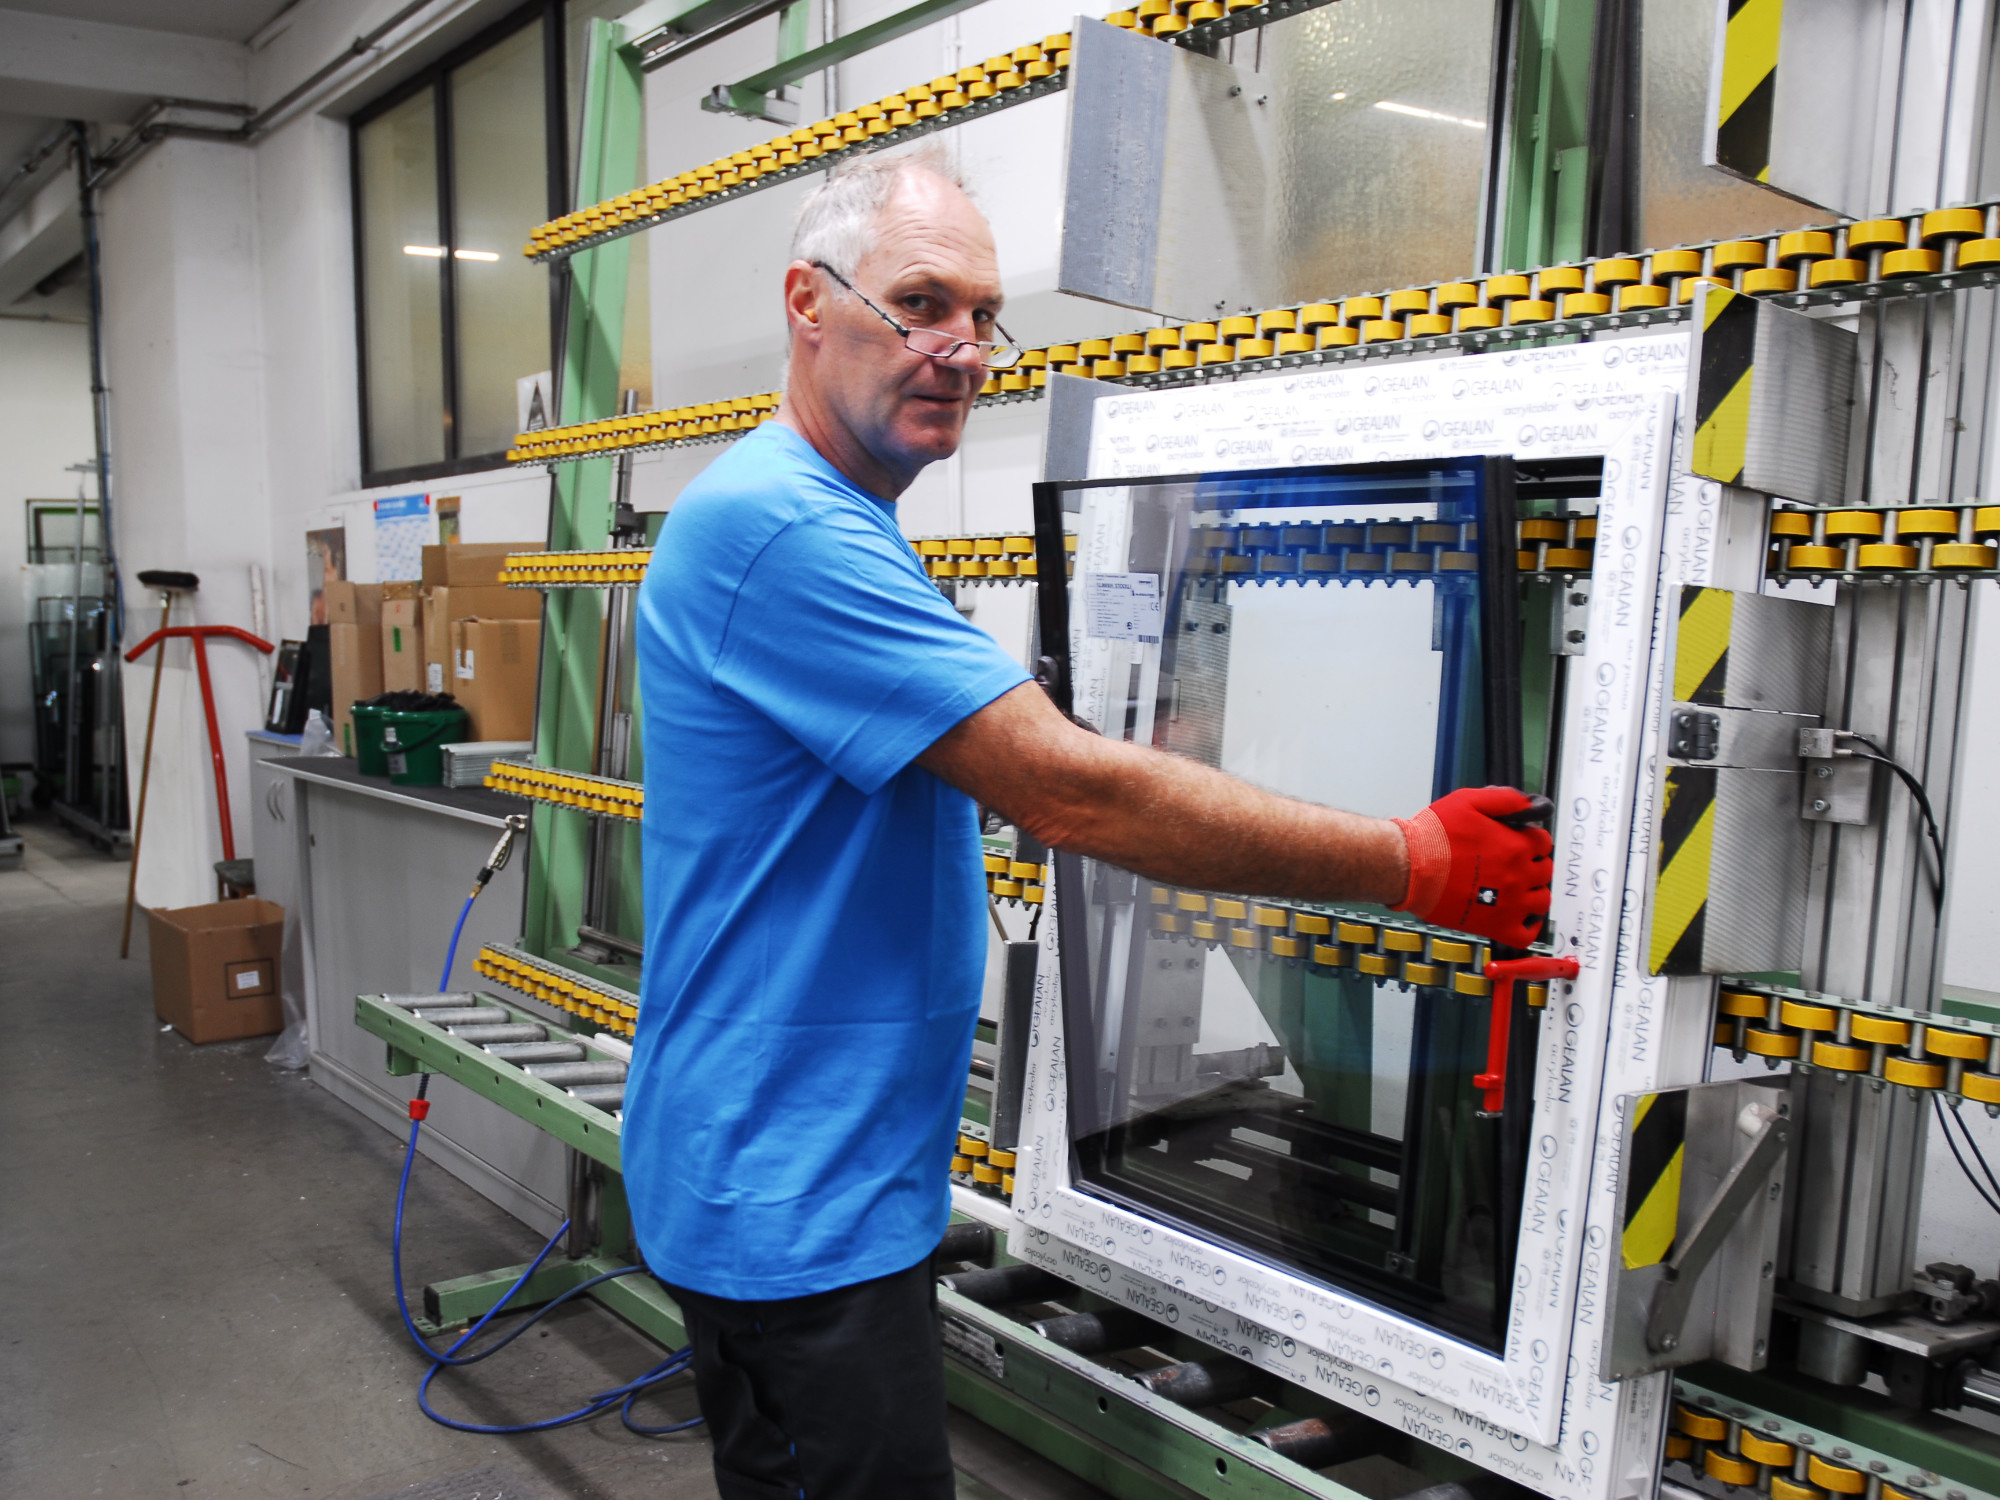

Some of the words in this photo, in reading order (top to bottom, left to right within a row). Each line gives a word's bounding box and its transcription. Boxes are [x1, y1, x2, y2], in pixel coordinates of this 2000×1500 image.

[1625, 342, 1687, 364] GEALAN
[1300, 373, 1344, 389] GEALAN
[1382, 374, 1430, 392] GEALAN
[1471, 377, 1523, 396] GEALAN
[1121, 400, 1156, 415] GEALAN
[1503, 402, 1559, 417] acrylcolor
[1352, 414, 1402, 432] GEALAN
[1441, 418, 1495, 437] GEALAN
[1538, 423, 1598, 443] GEALAN
[1160, 434, 1199, 449] GEALAN
[1230, 439, 1273, 455] GEALAN
[1308, 445, 1354, 462] GEALAN
[1599, 486, 1617, 558] GEALAN
[1692, 509, 1713, 583] GEALAN
[1614, 552, 1637, 627] GEALAN
[1589, 689, 1611, 763] GEALAN
[1564, 824, 1586, 898] GEALAN
[1584, 895, 1605, 970] GEALAN
[1033, 974, 1045, 1028] GEALAN
[1631, 987, 1655, 1062] GEALAN
[1048, 1036, 1062, 1092] GEALAN
[1544, 1044, 1559, 1113] acrylcolor
[1557, 1029, 1579, 1104] GEALAN
[1027, 1063, 1037, 1114] acrylcolor
[1032, 1134, 1045, 1190] GEALAN
[1532, 1161, 1553, 1235] GEALAN
[1066, 1223, 1103, 1248] GEALAN
[1101, 1211, 1140, 1237] GEALAN
[1063, 1249, 1099, 1276] GEALAN
[1170, 1250, 1212, 1277] GEALAN
[1127, 1287, 1166, 1316] GEALAN
[1237, 1275, 1281, 1298] acrylcolor
[1579, 1252, 1601, 1326] GEALAN
[1244, 1291, 1290, 1321] GEALAN
[1236, 1318, 1281, 1349] GEALAN
[1319, 1320, 1367, 1345] acrylcolor
[1374, 1326, 1426, 1360] GEALAN
[1326, 1338, 1376, 1369] GEALAN
[1315, 1365, 1363, 1397] GEALAN
[1407, 1370, 1460, 1397] acrylcolor
[1584, 1338, 1600, 1412] acrylcolor
[1393, 1397, 1444, 1424] acrylcolor
[1469, 1377, 1525, 1415] GEALAN
[1488, 1451, 1544, 1482] acrylcolor
